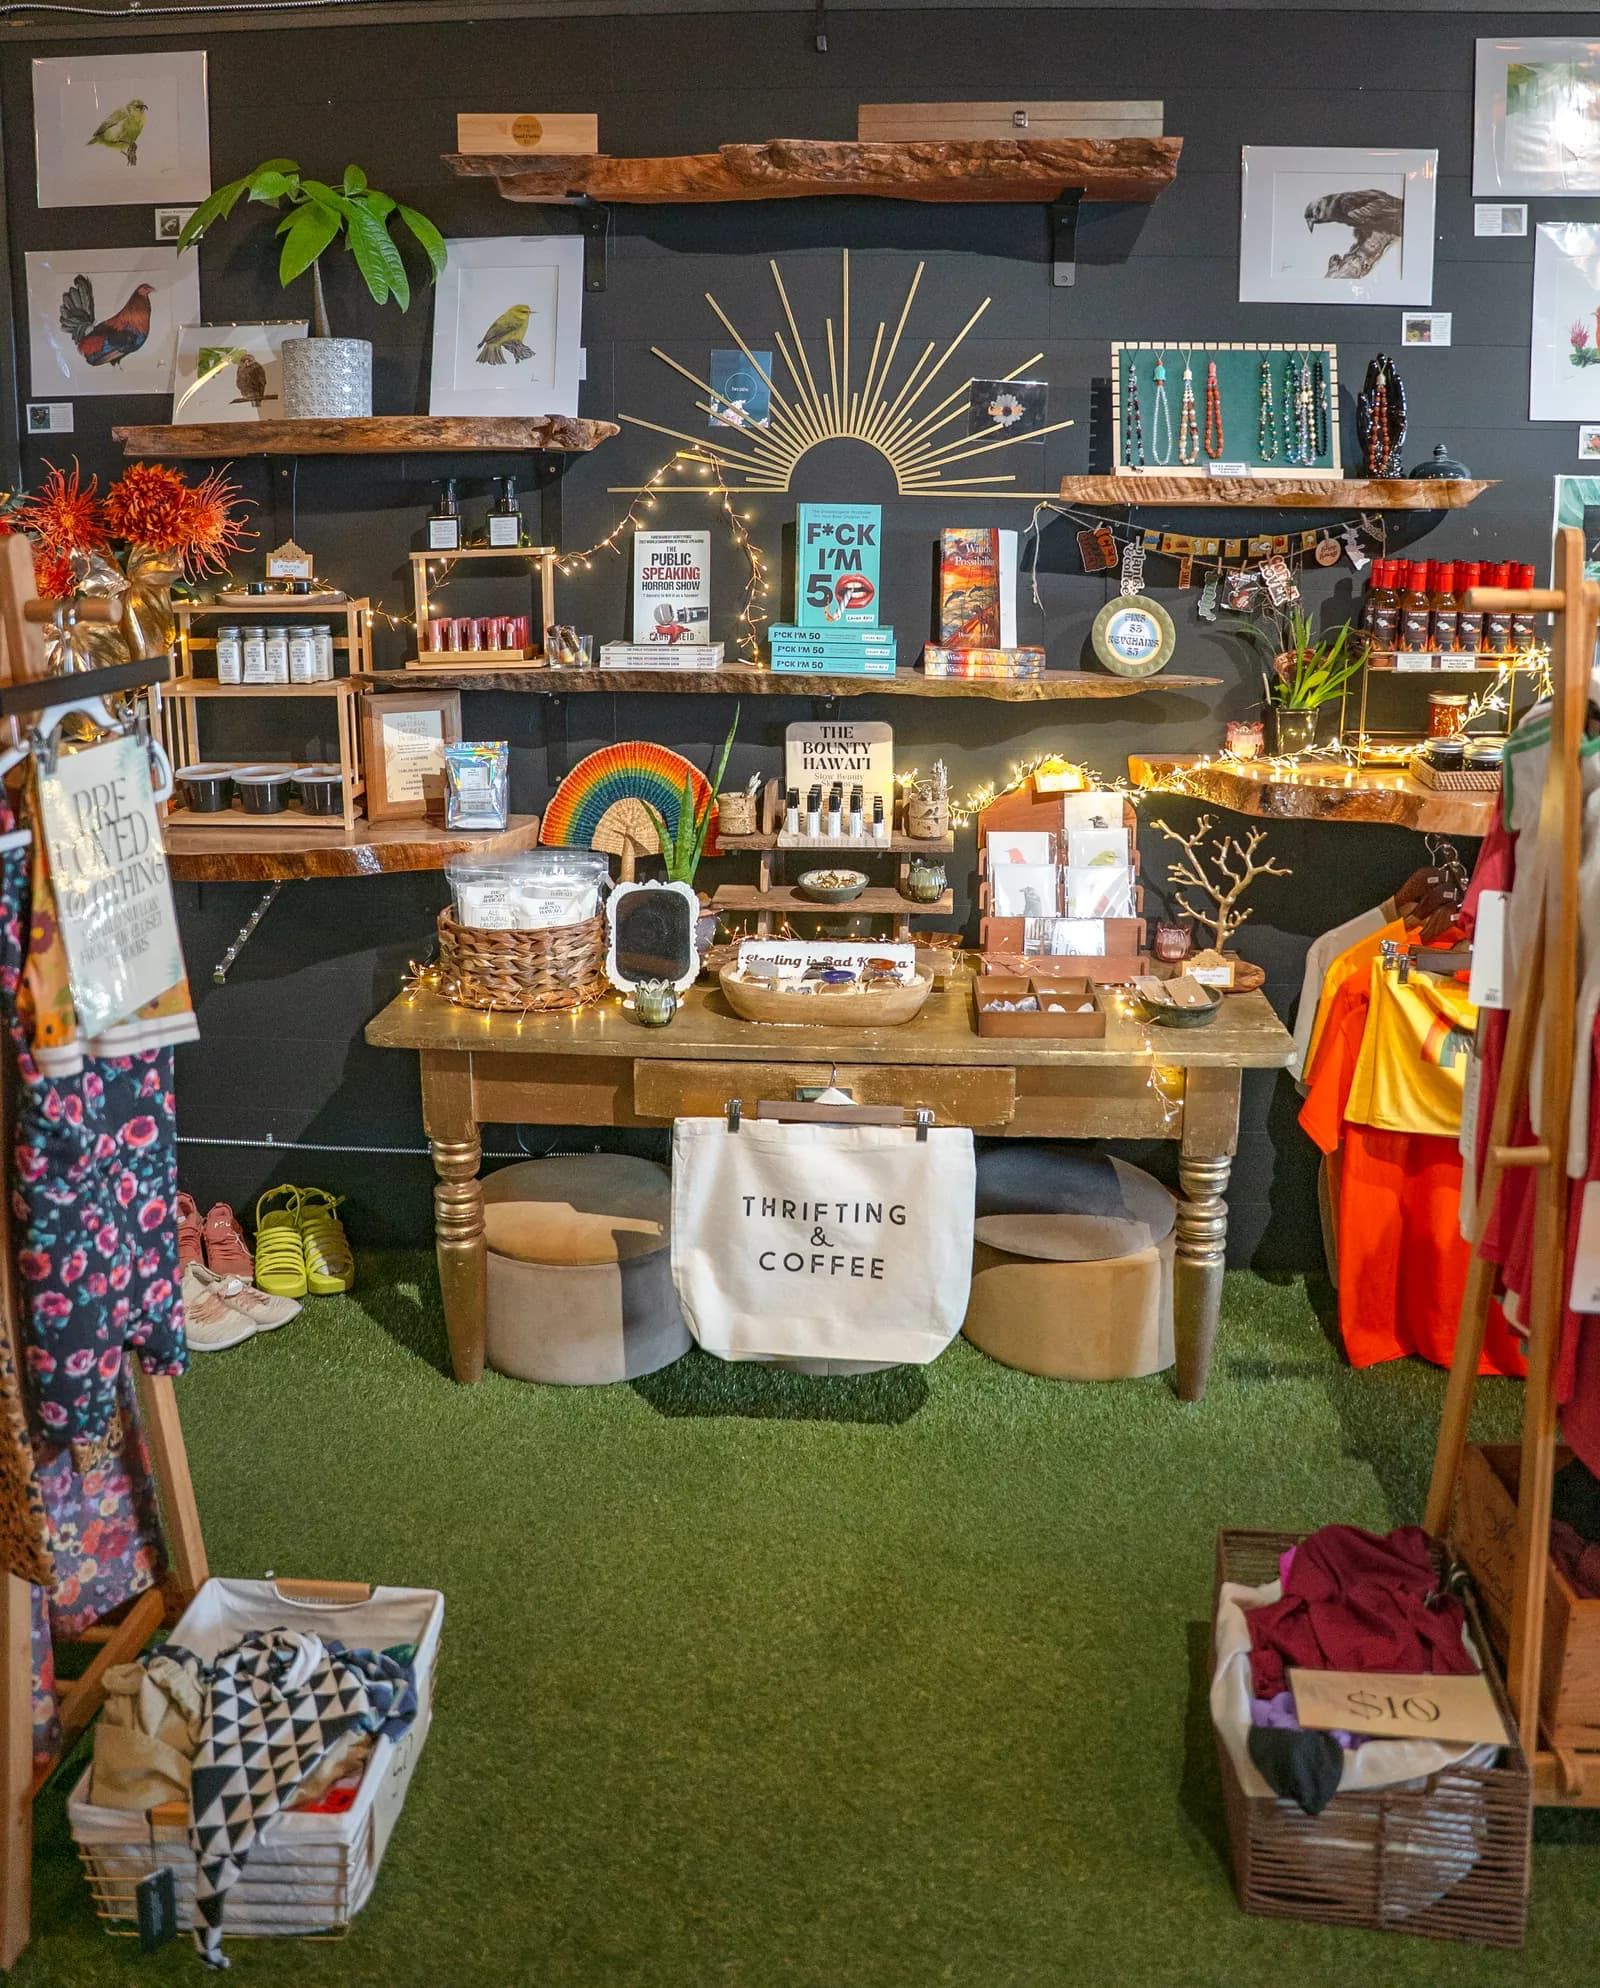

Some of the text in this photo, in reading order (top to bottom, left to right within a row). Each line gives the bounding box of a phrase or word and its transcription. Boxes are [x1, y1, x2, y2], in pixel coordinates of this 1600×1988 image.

[651, 553, 691, 566] PUBLIC
[818, 548, 862, 571] I'M
[642, 567, 700, 580] SPEAKING
[642, 581, 700, 590] HORROR SHOW
[1125, 613, 1146, 622] PINS
[1108, 636, 1159, 647] KEYCHAINS
[820, 726, 854, 738] THE
[803, 742, 871, 754] BOUNTY
[72, 777, 126, 836] PRE
[822, 956, 854, 967] Bad
[743, 1196, 906, 1225] THRIFTING
[810, 1226, 834, 1247] &
[759, 1252, 884, 1279] COFFEE
[1347, 1690, 1440, 1722] $10
